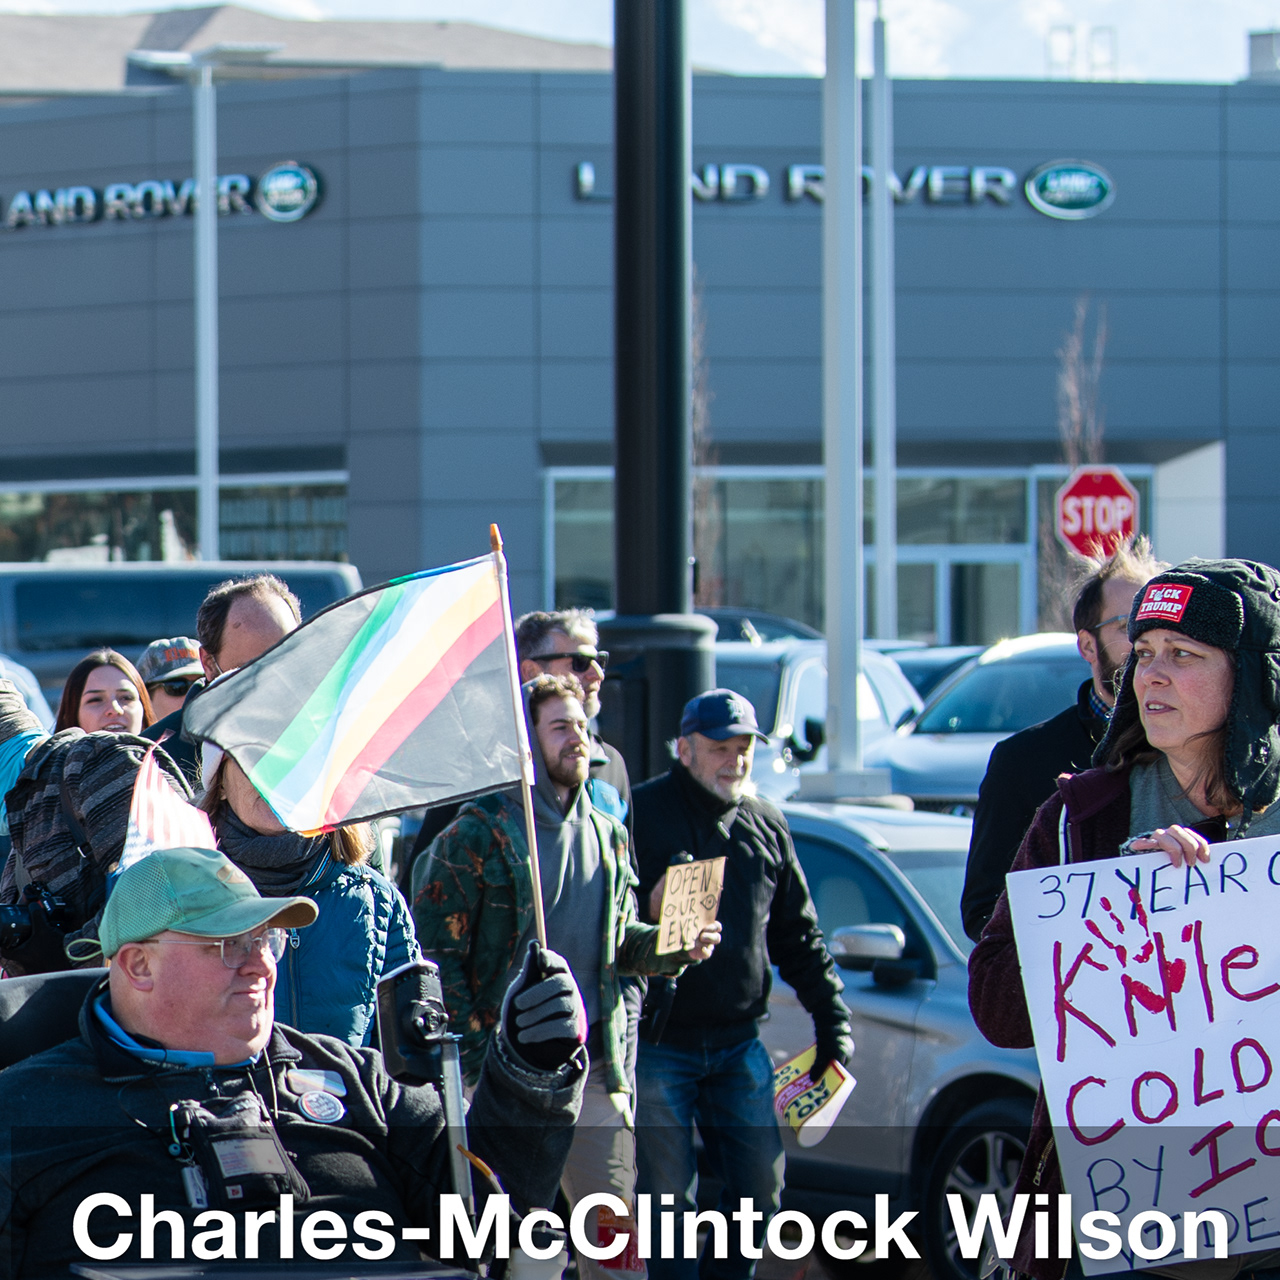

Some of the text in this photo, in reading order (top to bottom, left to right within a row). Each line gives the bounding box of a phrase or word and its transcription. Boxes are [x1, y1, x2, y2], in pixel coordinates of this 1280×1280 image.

[102, 172, 252, 221] ROVR
[578, 161, 771, 200] LND
[788, 165, 1018, 203] RVER
[1063, 496, 1131, 535] STOP
[1141, 601, 1183, 613] TRUMP
[670, 861, 714, 895] OPEN
[1038, 871, 1096, 919] 37
[1115, 850, 1249, 920] YEAR
[680, 897, 696, 916] UR
[797, 1088, 832, 1119] NO
[1066, 1037, 1272, 1146] COLD
[1086, 1145, 1164, 1216] BY
